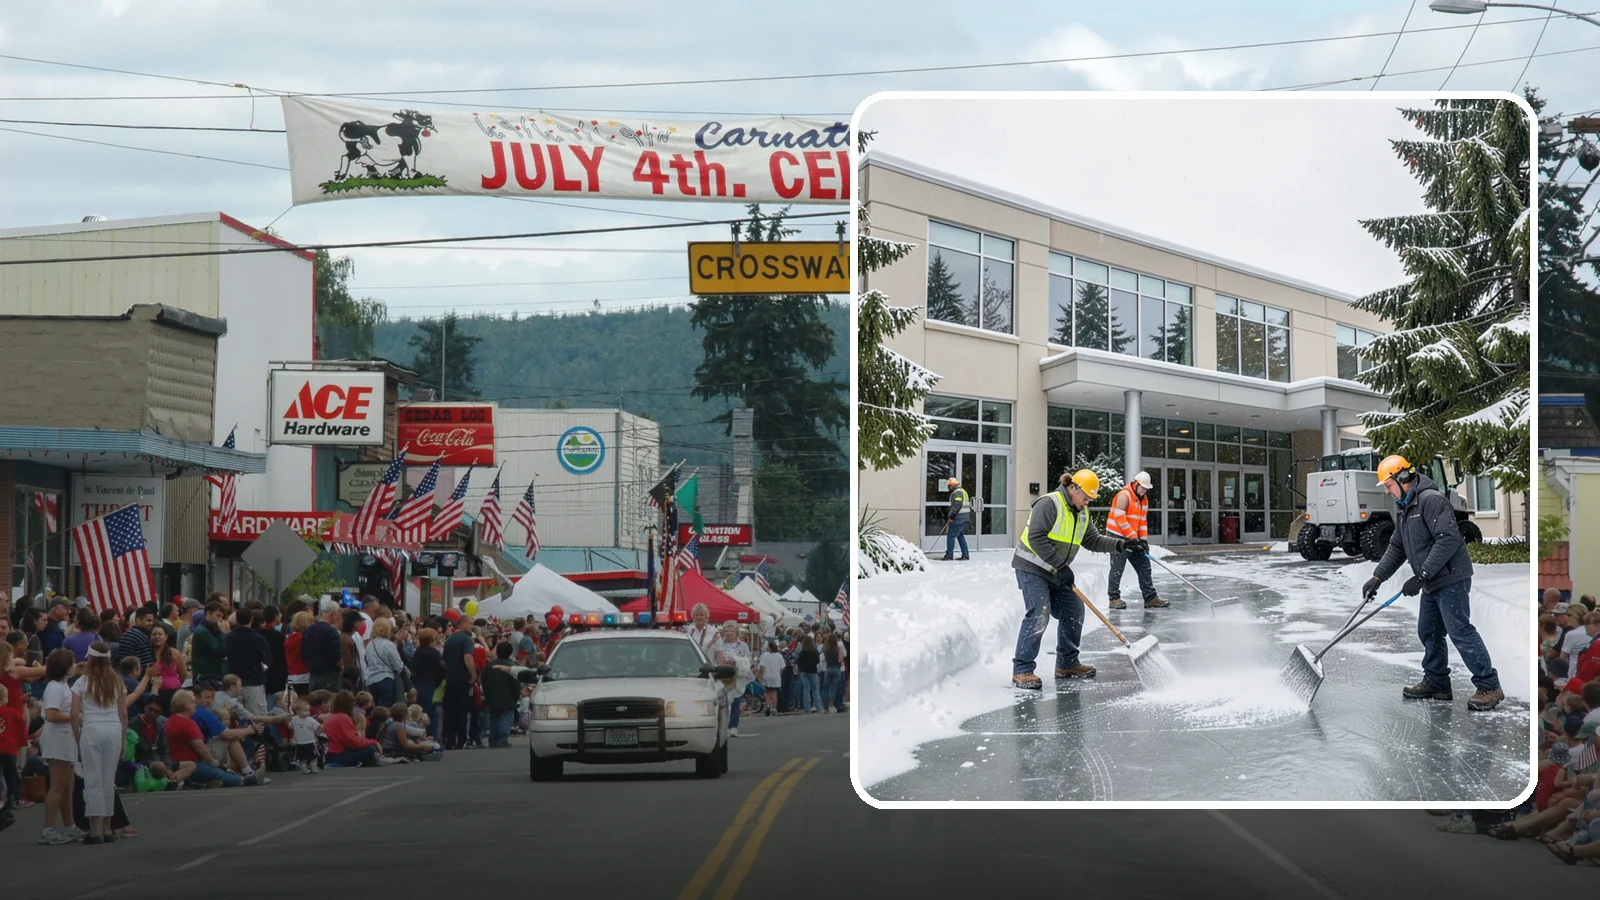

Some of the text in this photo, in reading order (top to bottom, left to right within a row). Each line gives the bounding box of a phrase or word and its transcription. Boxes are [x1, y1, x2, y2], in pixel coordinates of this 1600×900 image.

[695, 121, 850, 150] Carnat
[481, 141, 604, 192] JULY
[632, 150, 746, 197] 4th.
[697, 254, 850, 280] CROSSWA
[282, 380, 374, 419] ACE
[405, 409, 453, 422] CEDAR
[283, 421, 371, 436] Hardware
[416, 428, 477, 447] Coca-Cola
[83, 485, 155, 495] St. Vincent de Paul
[688, 526, 741, 535] CRNATION
[699, 535, 730, 543] GLASS
